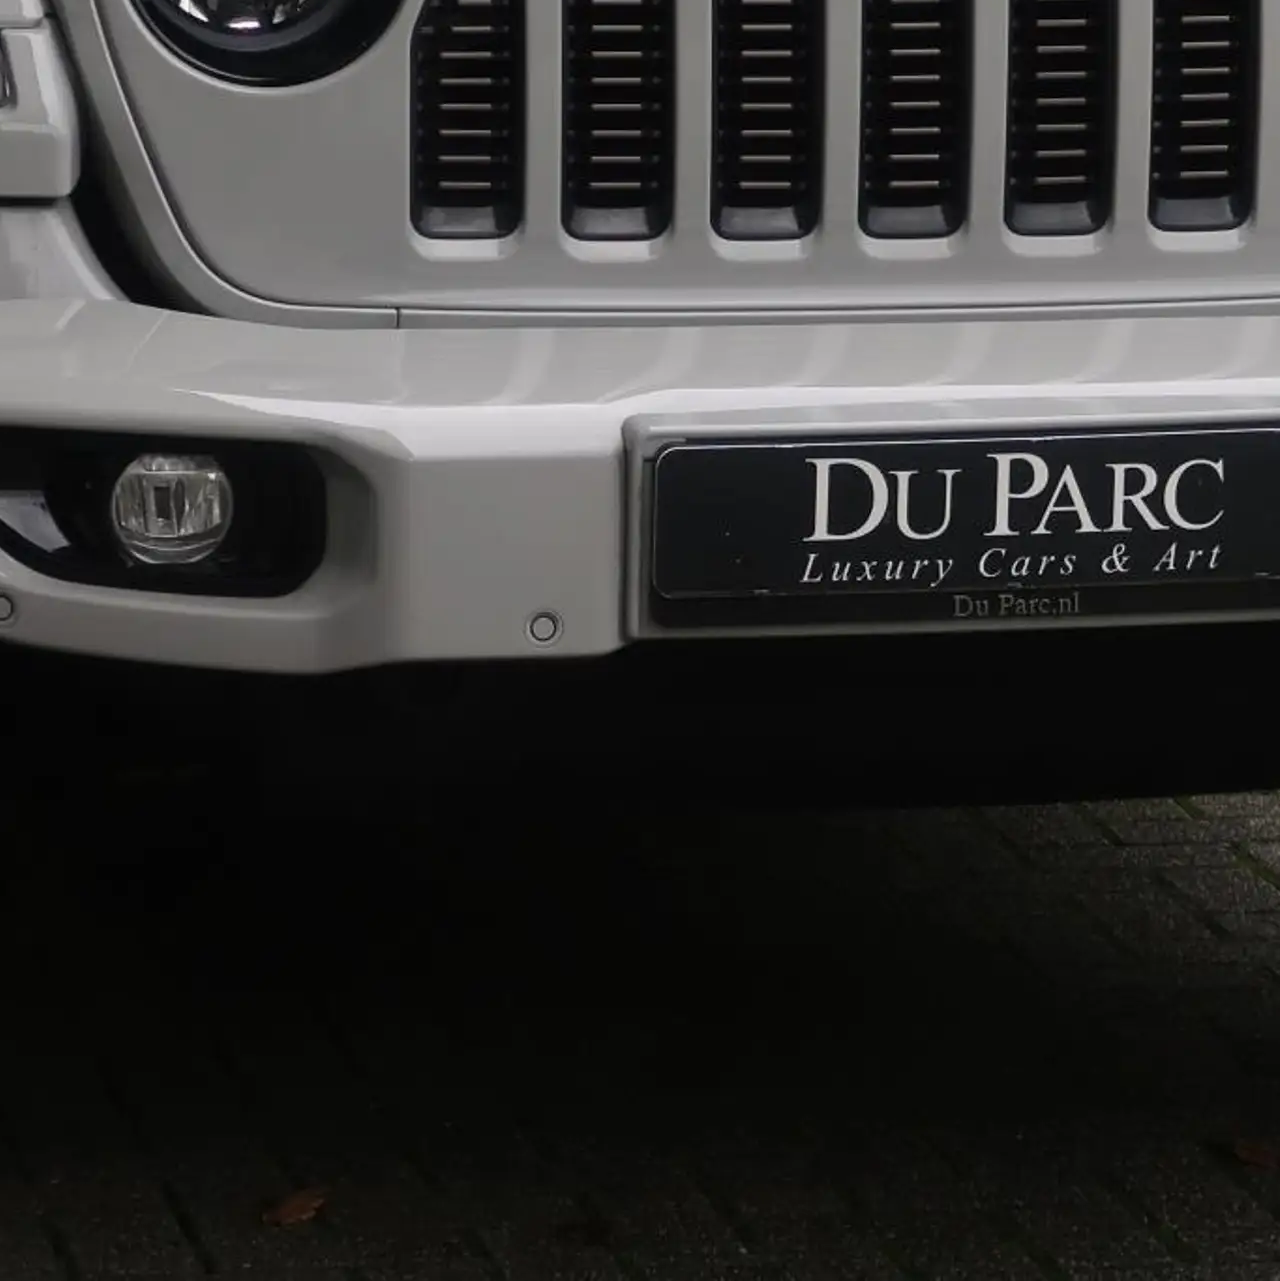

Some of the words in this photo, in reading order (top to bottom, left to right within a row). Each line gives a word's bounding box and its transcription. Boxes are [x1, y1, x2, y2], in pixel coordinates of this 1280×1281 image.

[800, 553, 953, 587] Luxury
[979, 547, 1076, 578] Cars
[1101, 543, 1131, 574] &
[1154, 542, 1221, 571] Art
[953, 594, 989, 618] Du
